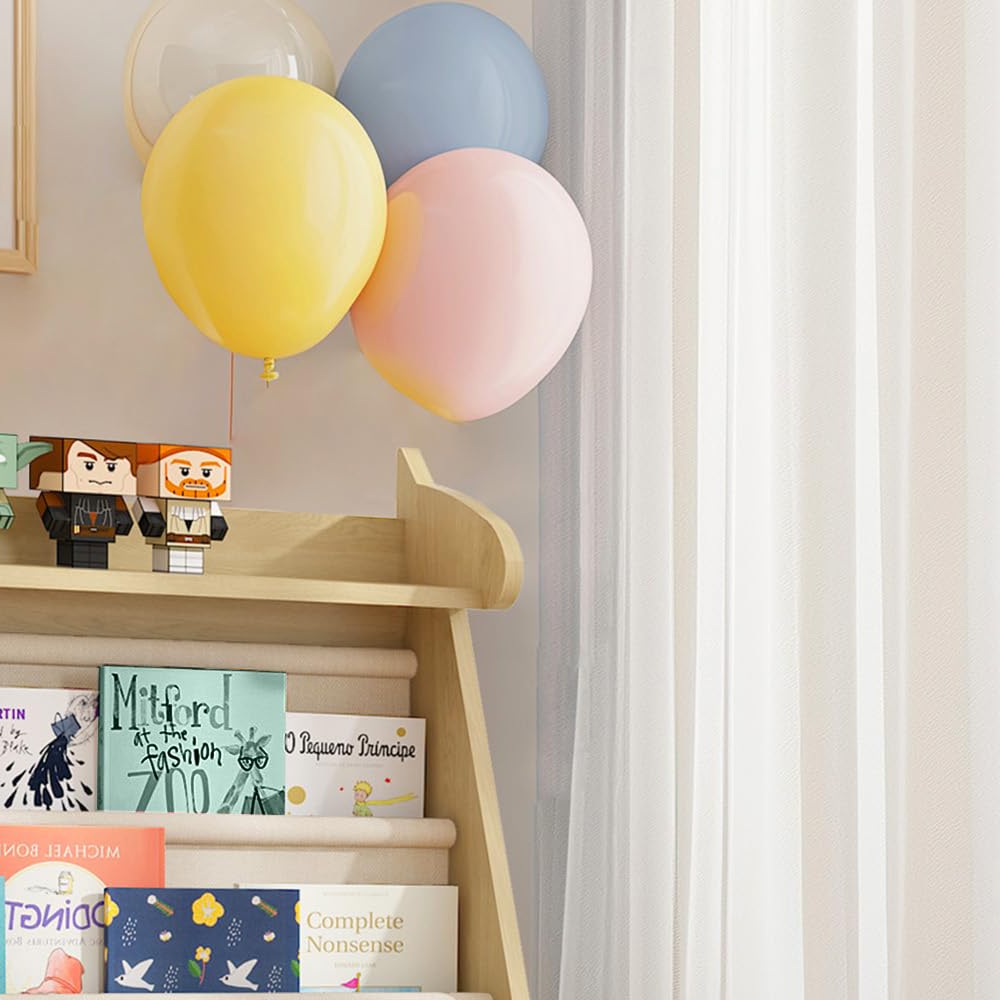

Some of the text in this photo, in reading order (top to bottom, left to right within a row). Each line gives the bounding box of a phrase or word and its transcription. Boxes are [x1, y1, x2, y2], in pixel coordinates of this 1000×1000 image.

[110, 672, 233, 731] Mitford
[133, 724, 188, 747] at the
[299, 730, 355, 761] Pequeno
[140, 736, 223, 781] fashion
[306, 911, 404, 933] Complete
[306, 935, 404, 953] Nonsense
